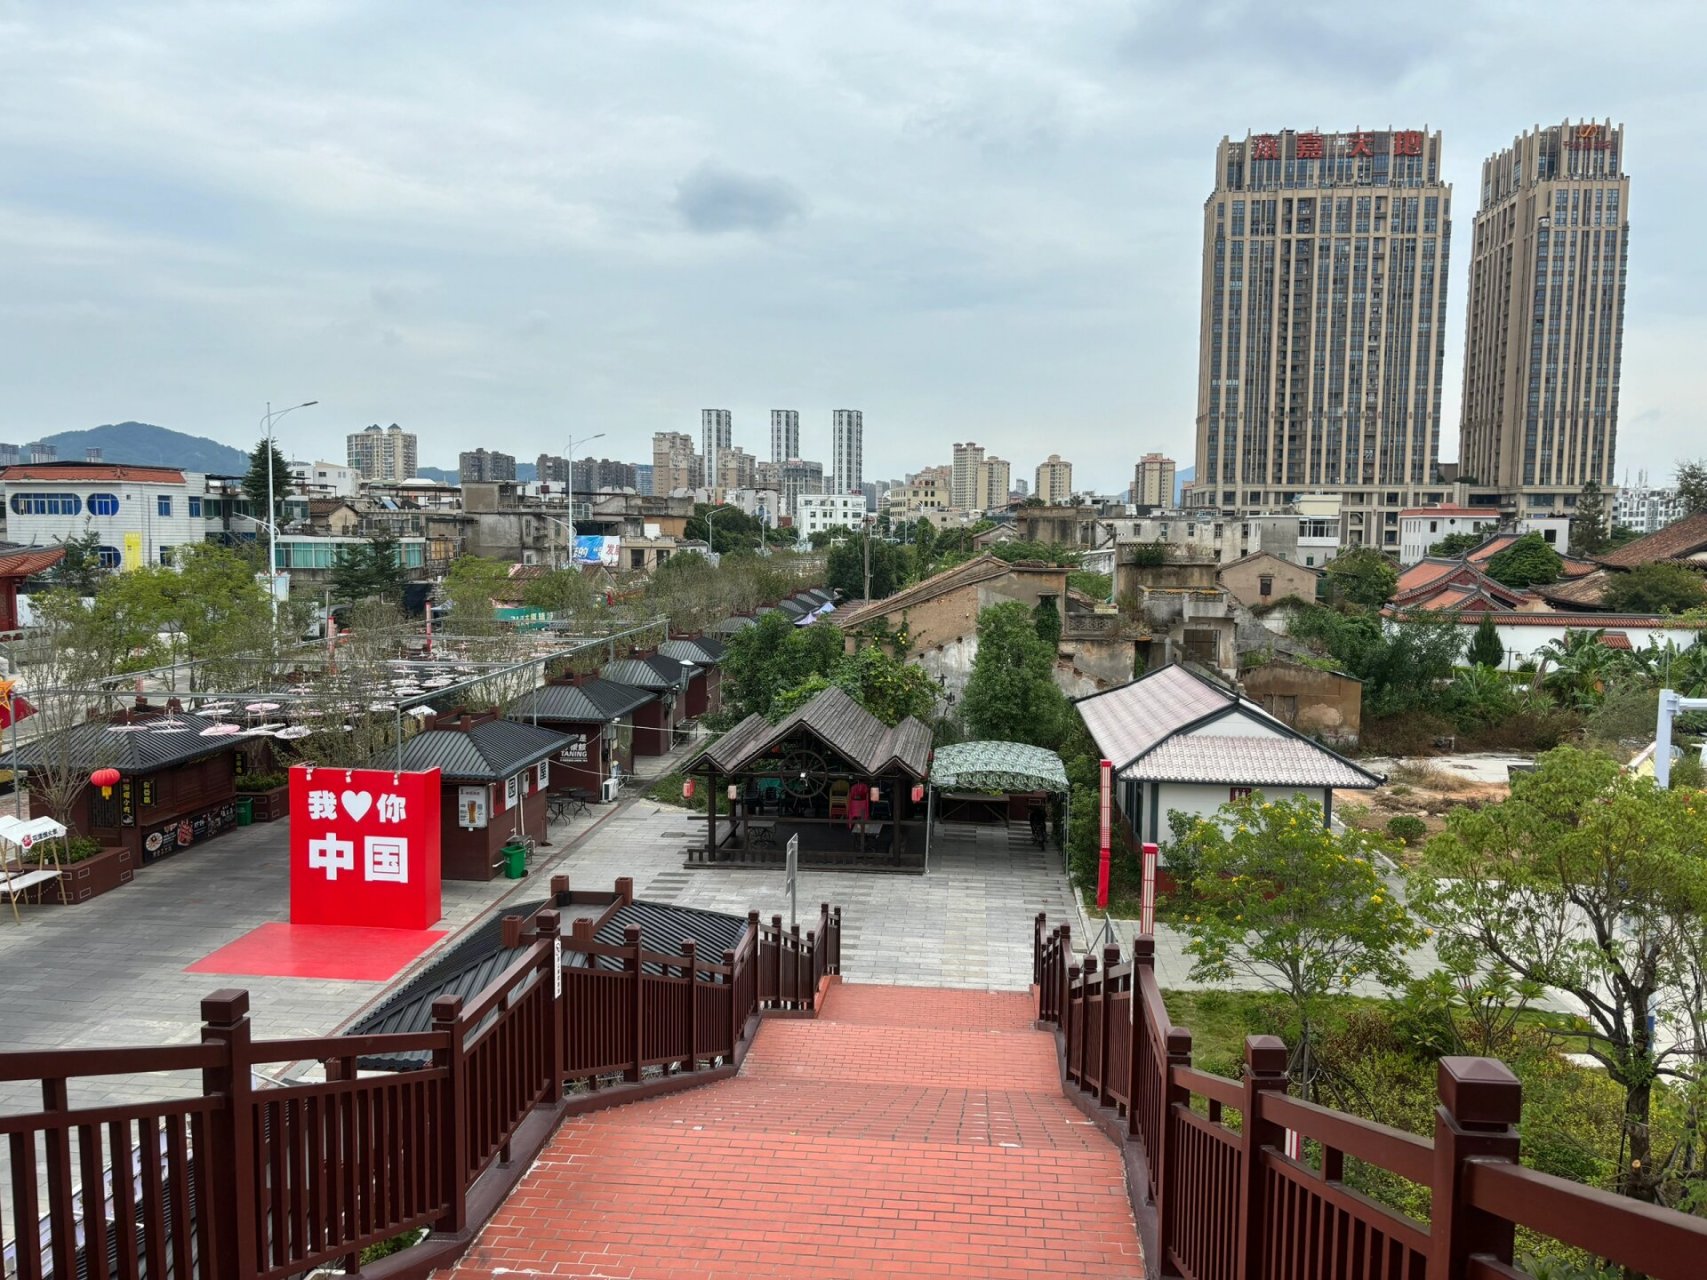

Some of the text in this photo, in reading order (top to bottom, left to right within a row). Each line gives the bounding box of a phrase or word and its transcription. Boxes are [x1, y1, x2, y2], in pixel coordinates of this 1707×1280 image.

[308, 790, 407, 823] 我 你
[308, 832, 409, 884] 中国
